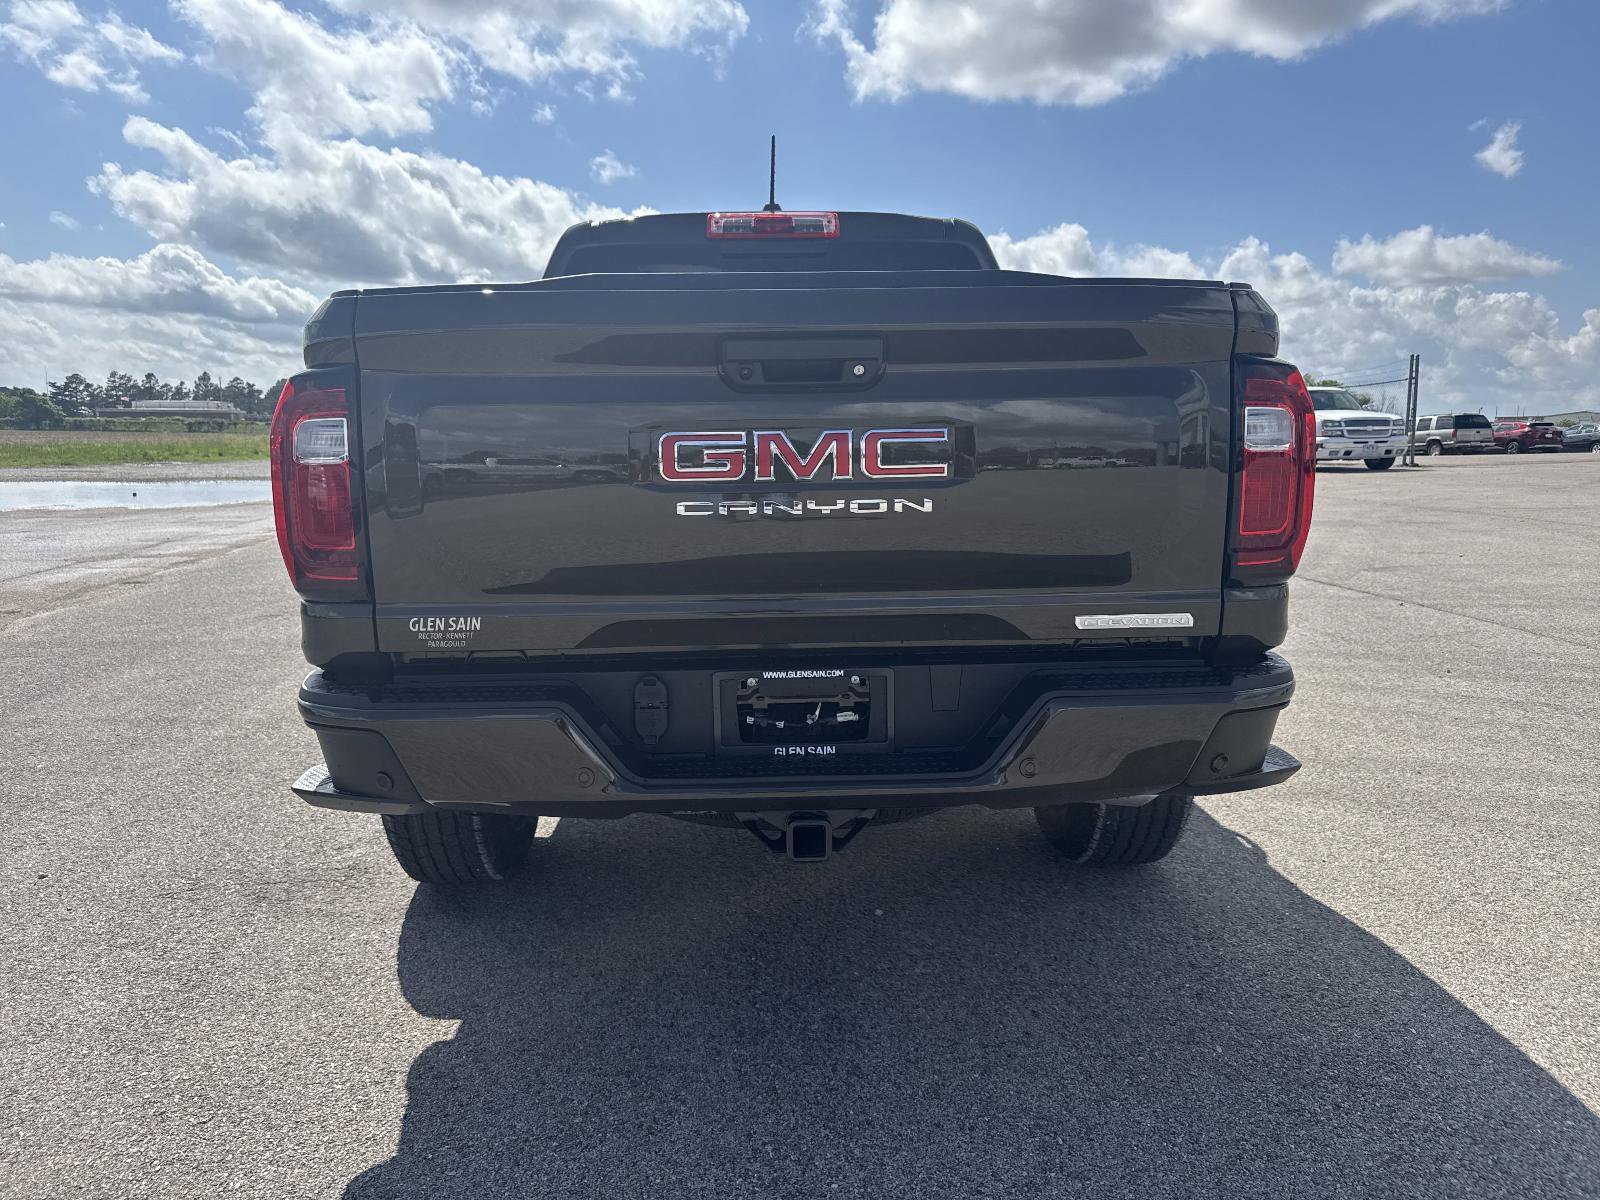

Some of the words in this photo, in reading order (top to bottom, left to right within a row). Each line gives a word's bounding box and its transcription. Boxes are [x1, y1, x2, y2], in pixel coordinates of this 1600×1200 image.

[659, 428, 948, 481] GMC
[676, 498, 933, 515] CANYON
[409, 617, 445, 631] GLEN
[448, 617, 481, 631] SAIN
[427, 640, 466, 648] PARAGOULD
[763, 670, 844, 679] WWW.GLENSAIN.COM
[774, 746, 805, 756] GLEN
[807, 746, 836, 756] SAIN
